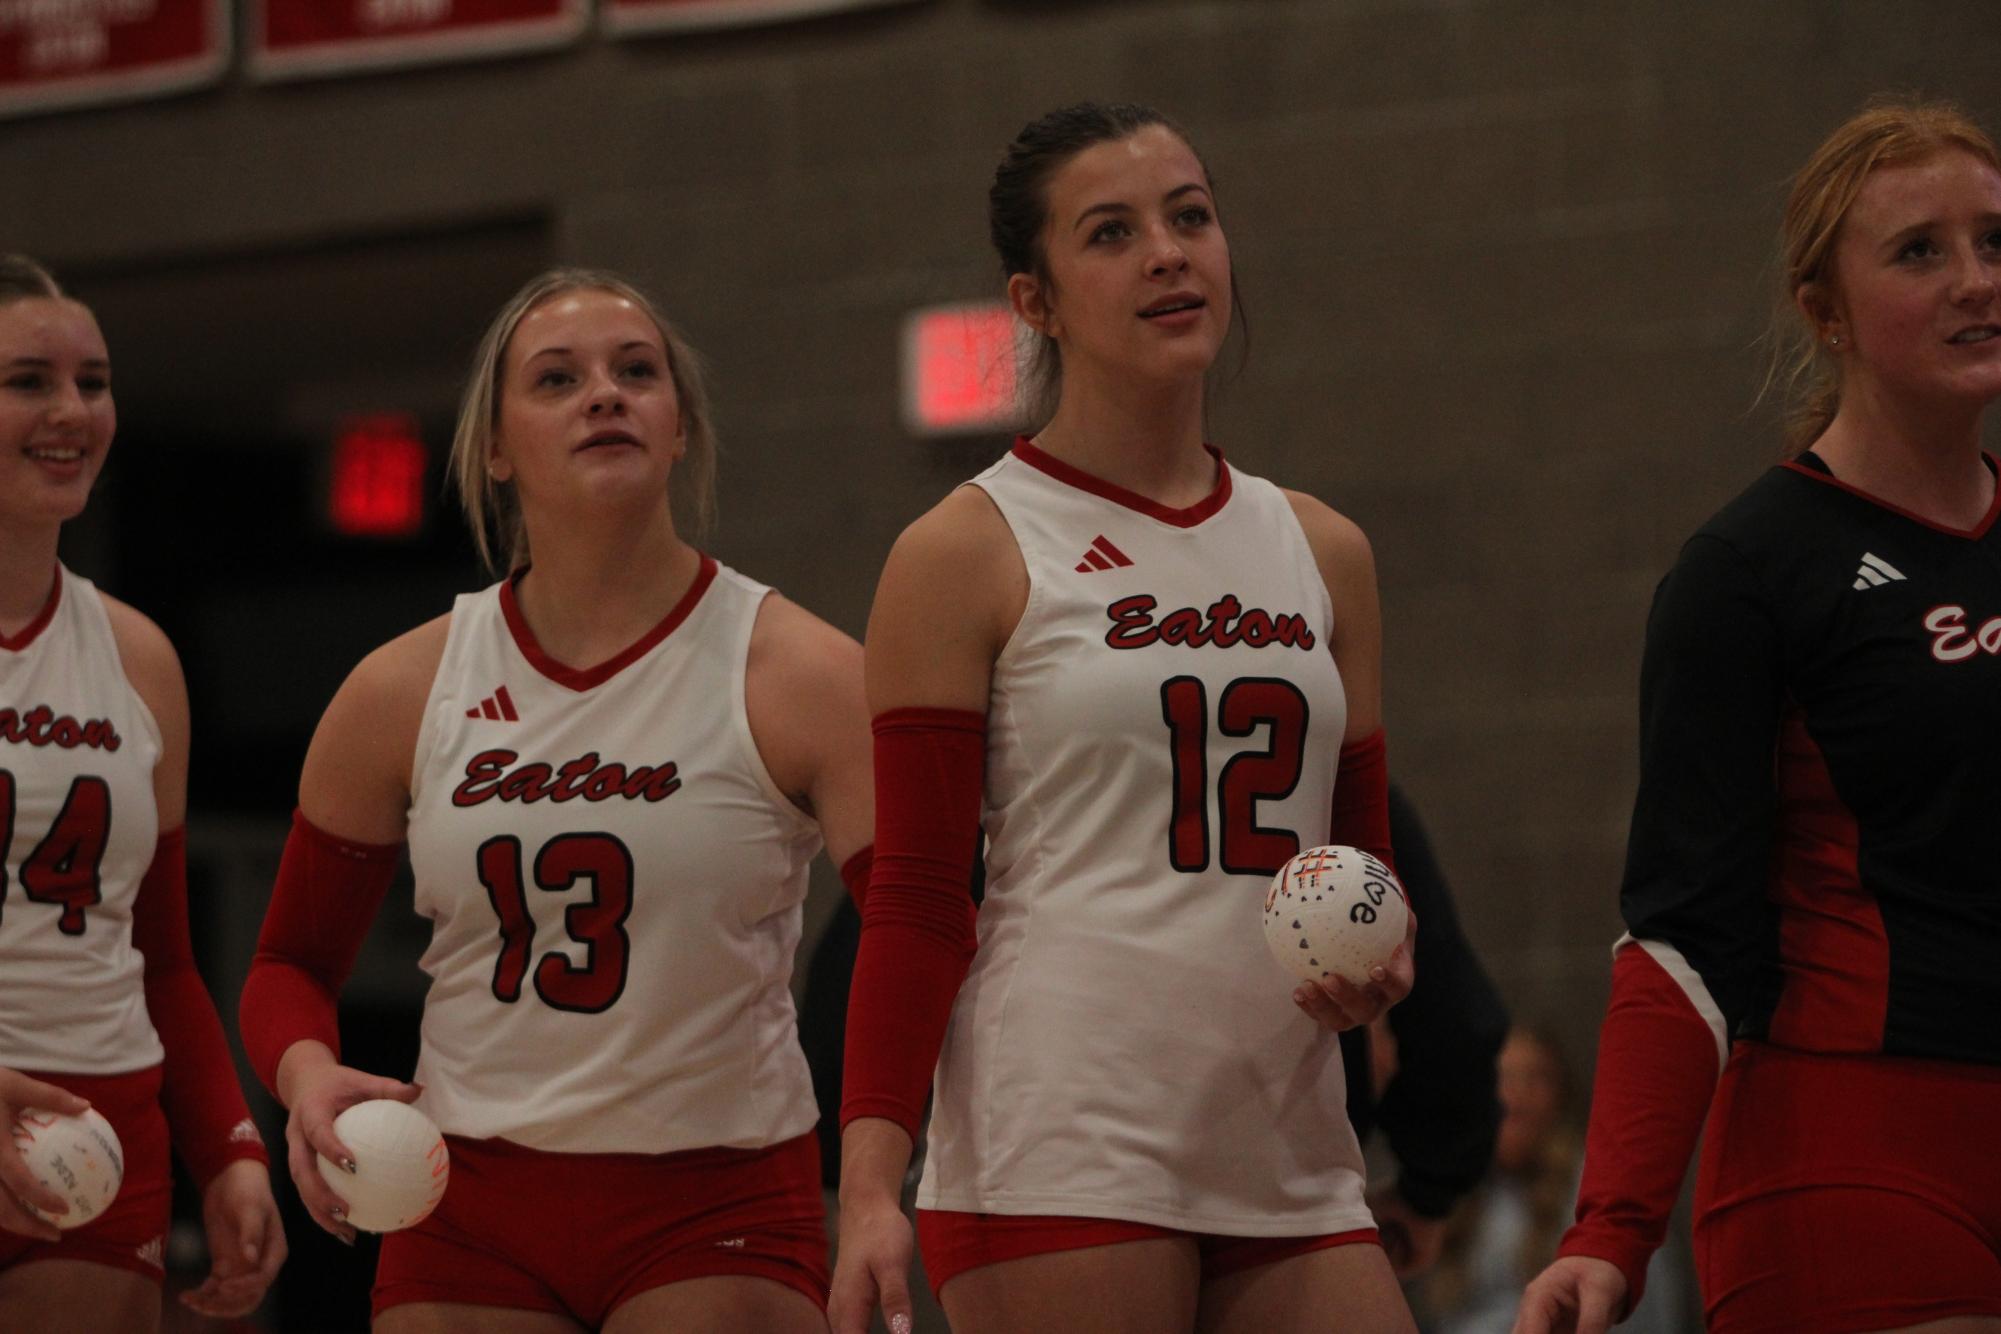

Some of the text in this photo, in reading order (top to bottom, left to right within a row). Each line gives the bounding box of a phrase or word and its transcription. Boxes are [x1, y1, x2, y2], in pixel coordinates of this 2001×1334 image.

[1105, 594, 1315, 651] Eaton
[452, 748, 682, 807] Eaton
[1160, 674, 1310, 876] 12
[476, 831, 634, 1014] 13
